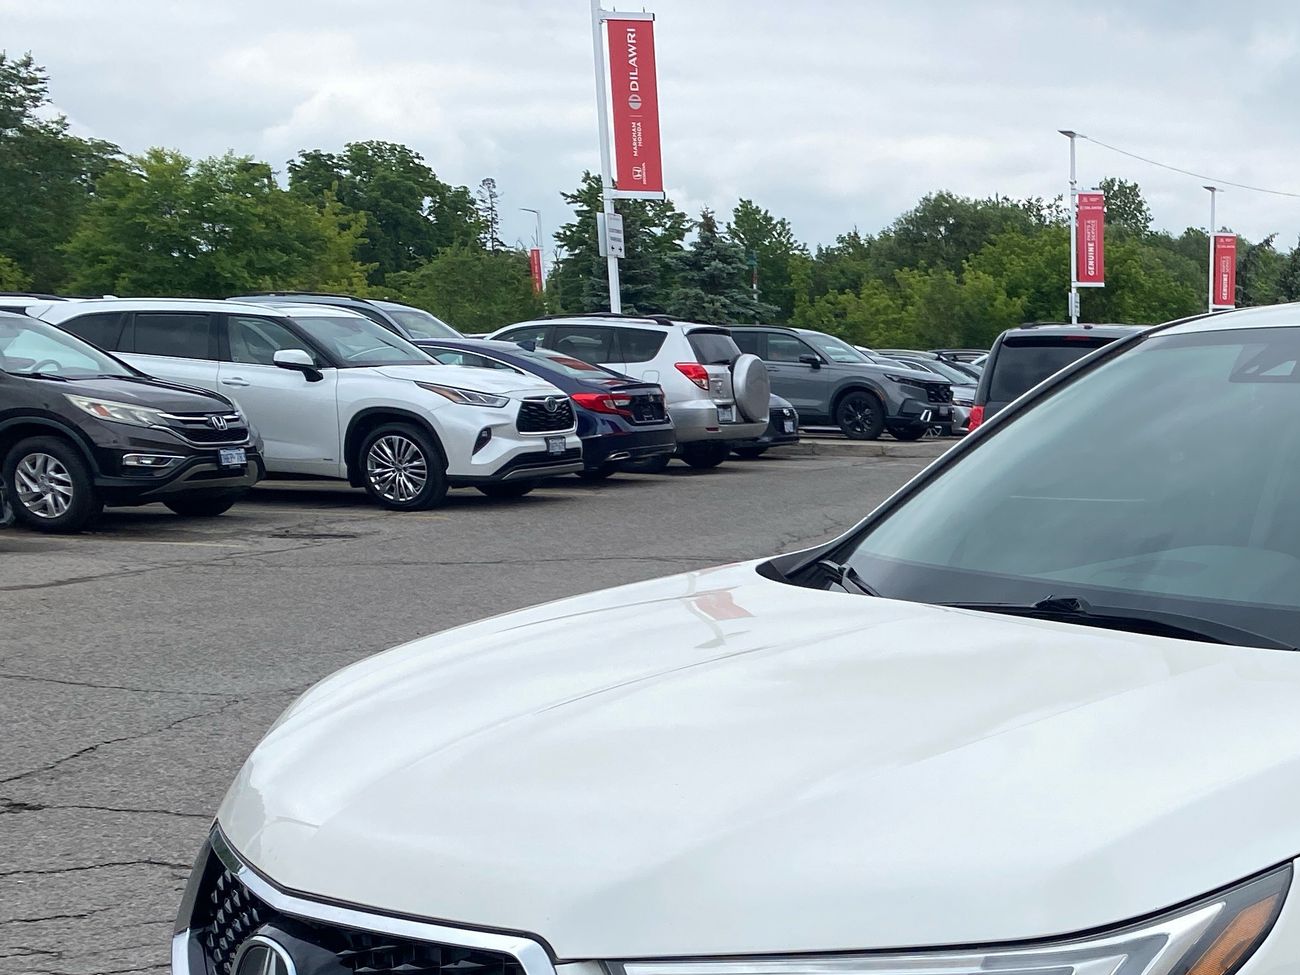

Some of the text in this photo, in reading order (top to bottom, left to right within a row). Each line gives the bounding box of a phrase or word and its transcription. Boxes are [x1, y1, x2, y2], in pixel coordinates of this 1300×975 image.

[626, 28, 640, 91] DILAWRI
[631, 121, 639, 157] MARKHAM
[1087, 242, 1095, 276] GENUINE
